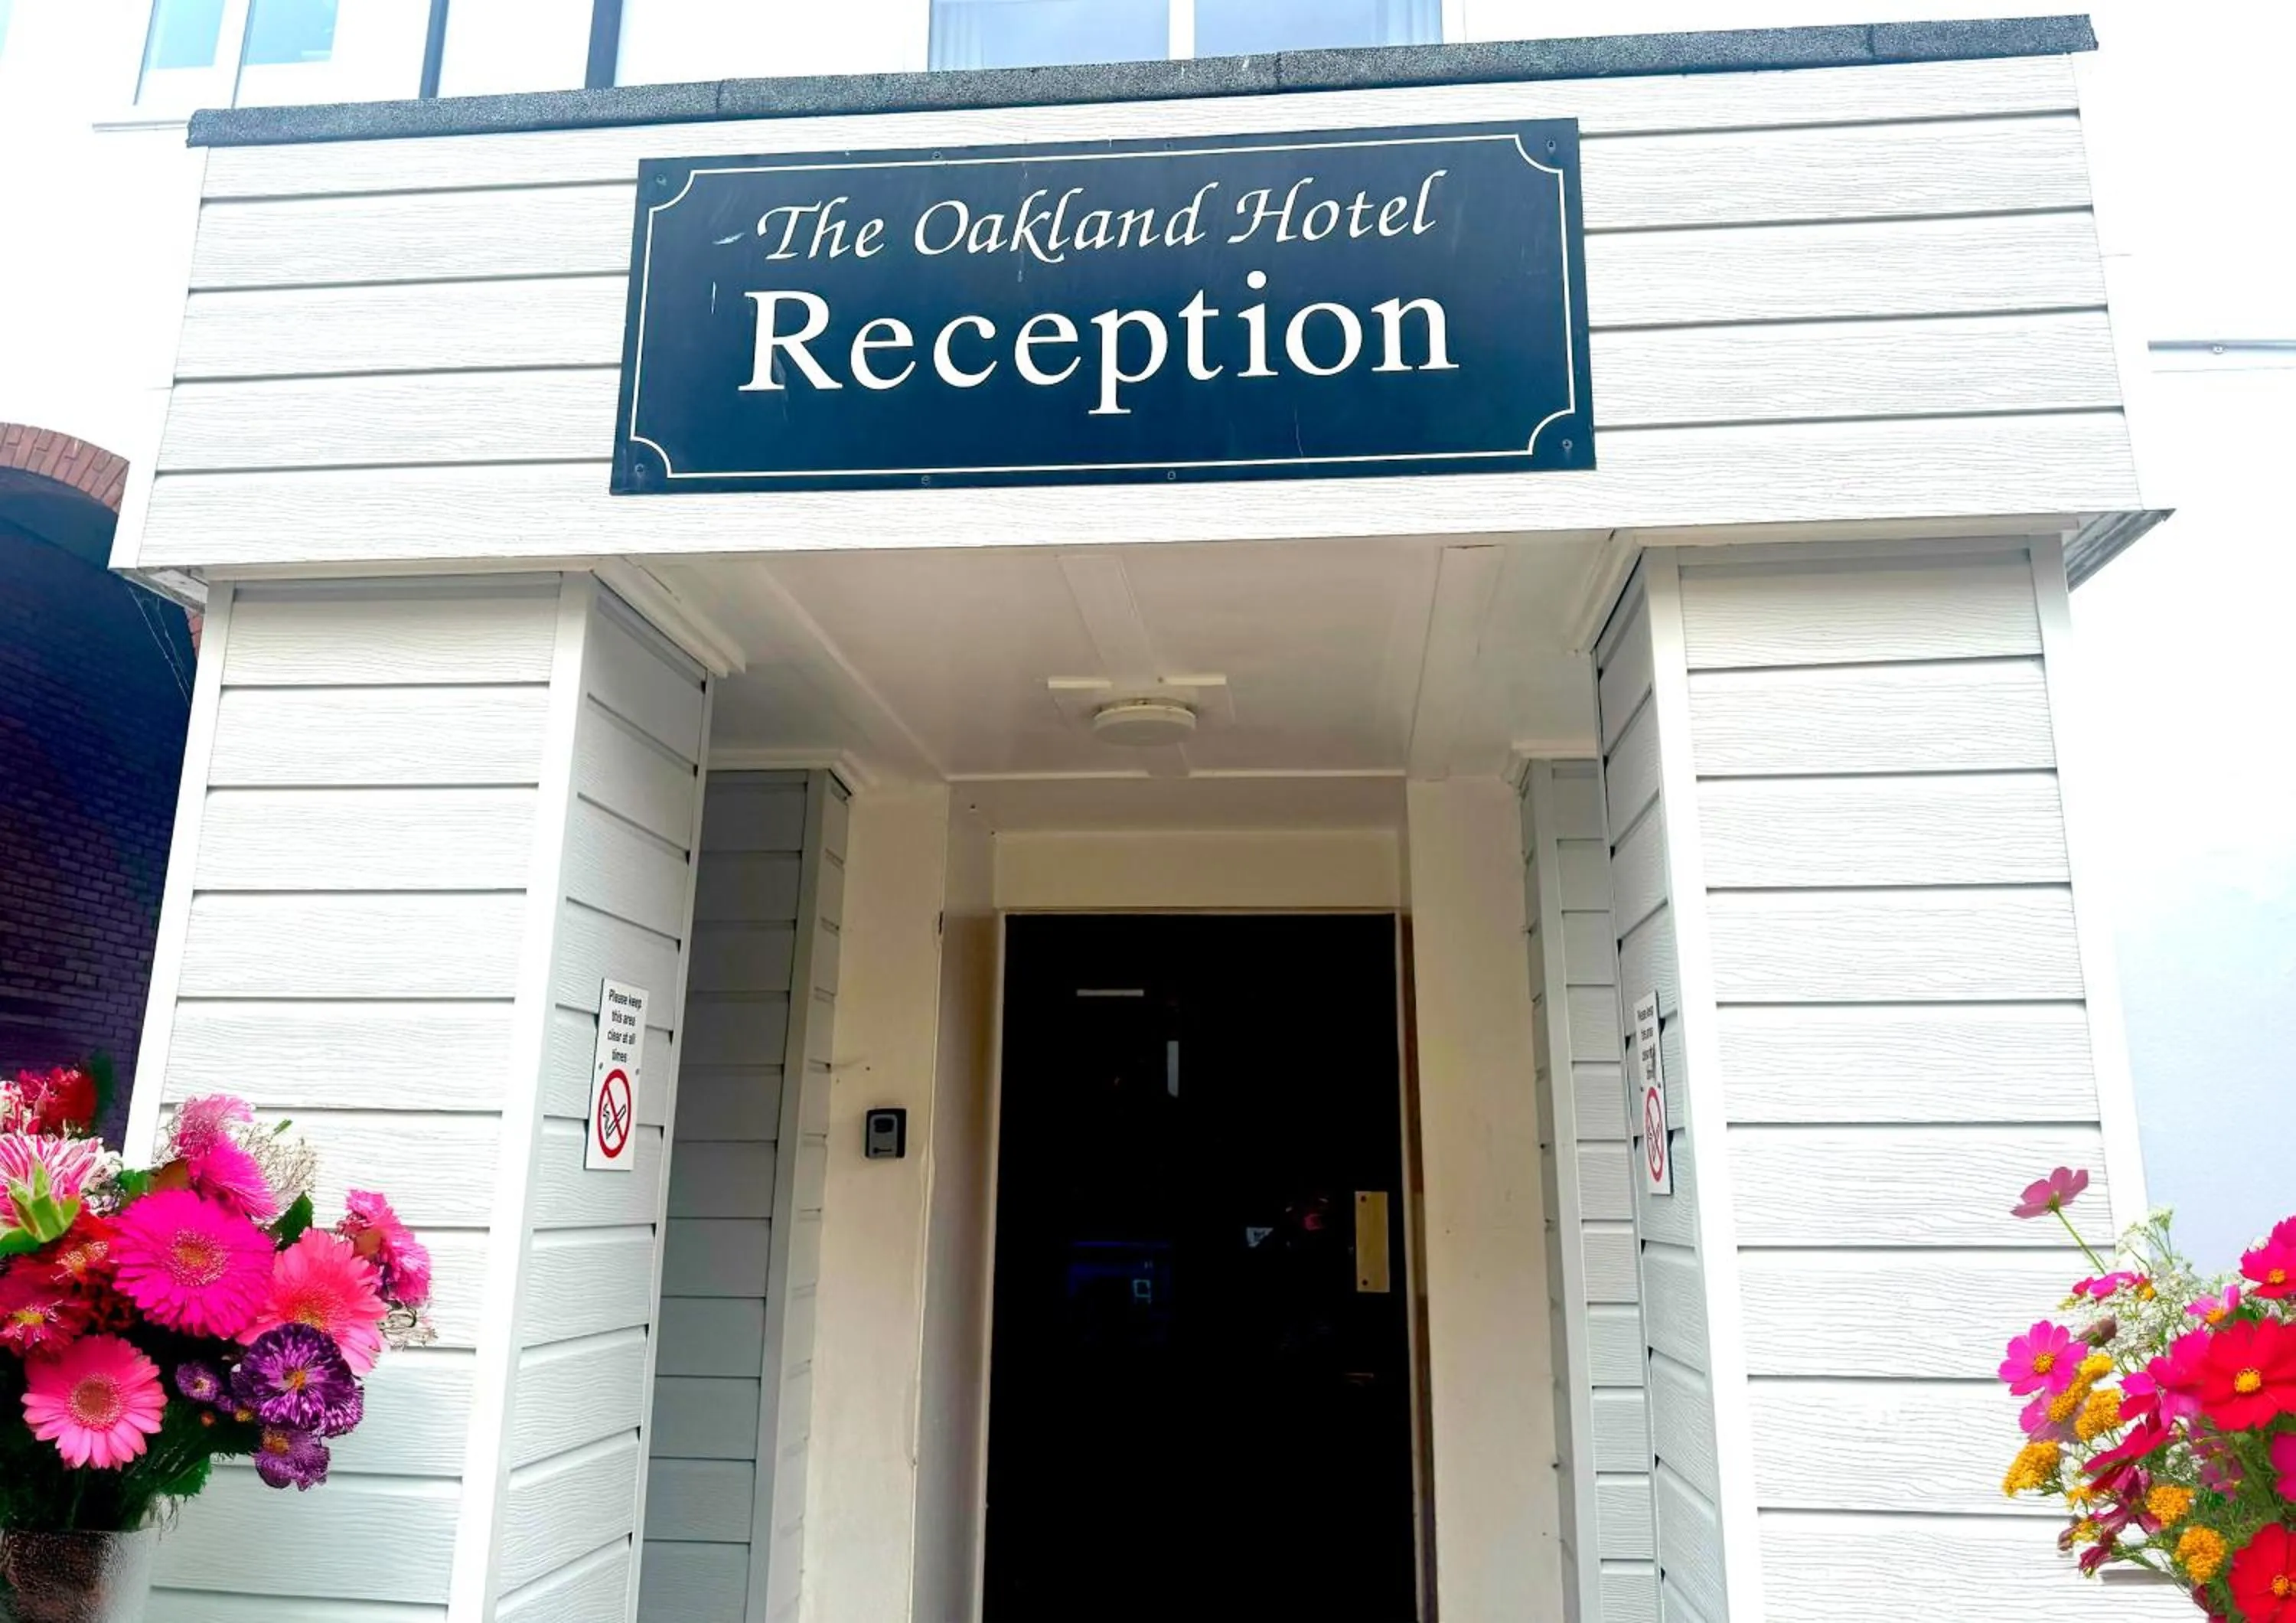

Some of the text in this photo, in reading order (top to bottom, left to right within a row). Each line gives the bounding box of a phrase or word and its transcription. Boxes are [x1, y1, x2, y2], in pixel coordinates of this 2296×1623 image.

[755, 169, 1448, 264] The Oakland Hotel
[738, 270, 1459, 415] Reception
[608, 988, 642, 1011] Please keep
[612, 1010, 636, 1026] this area
[608, 1030, 621, 1042] clear
[612, 1048, 628, 1063] times
